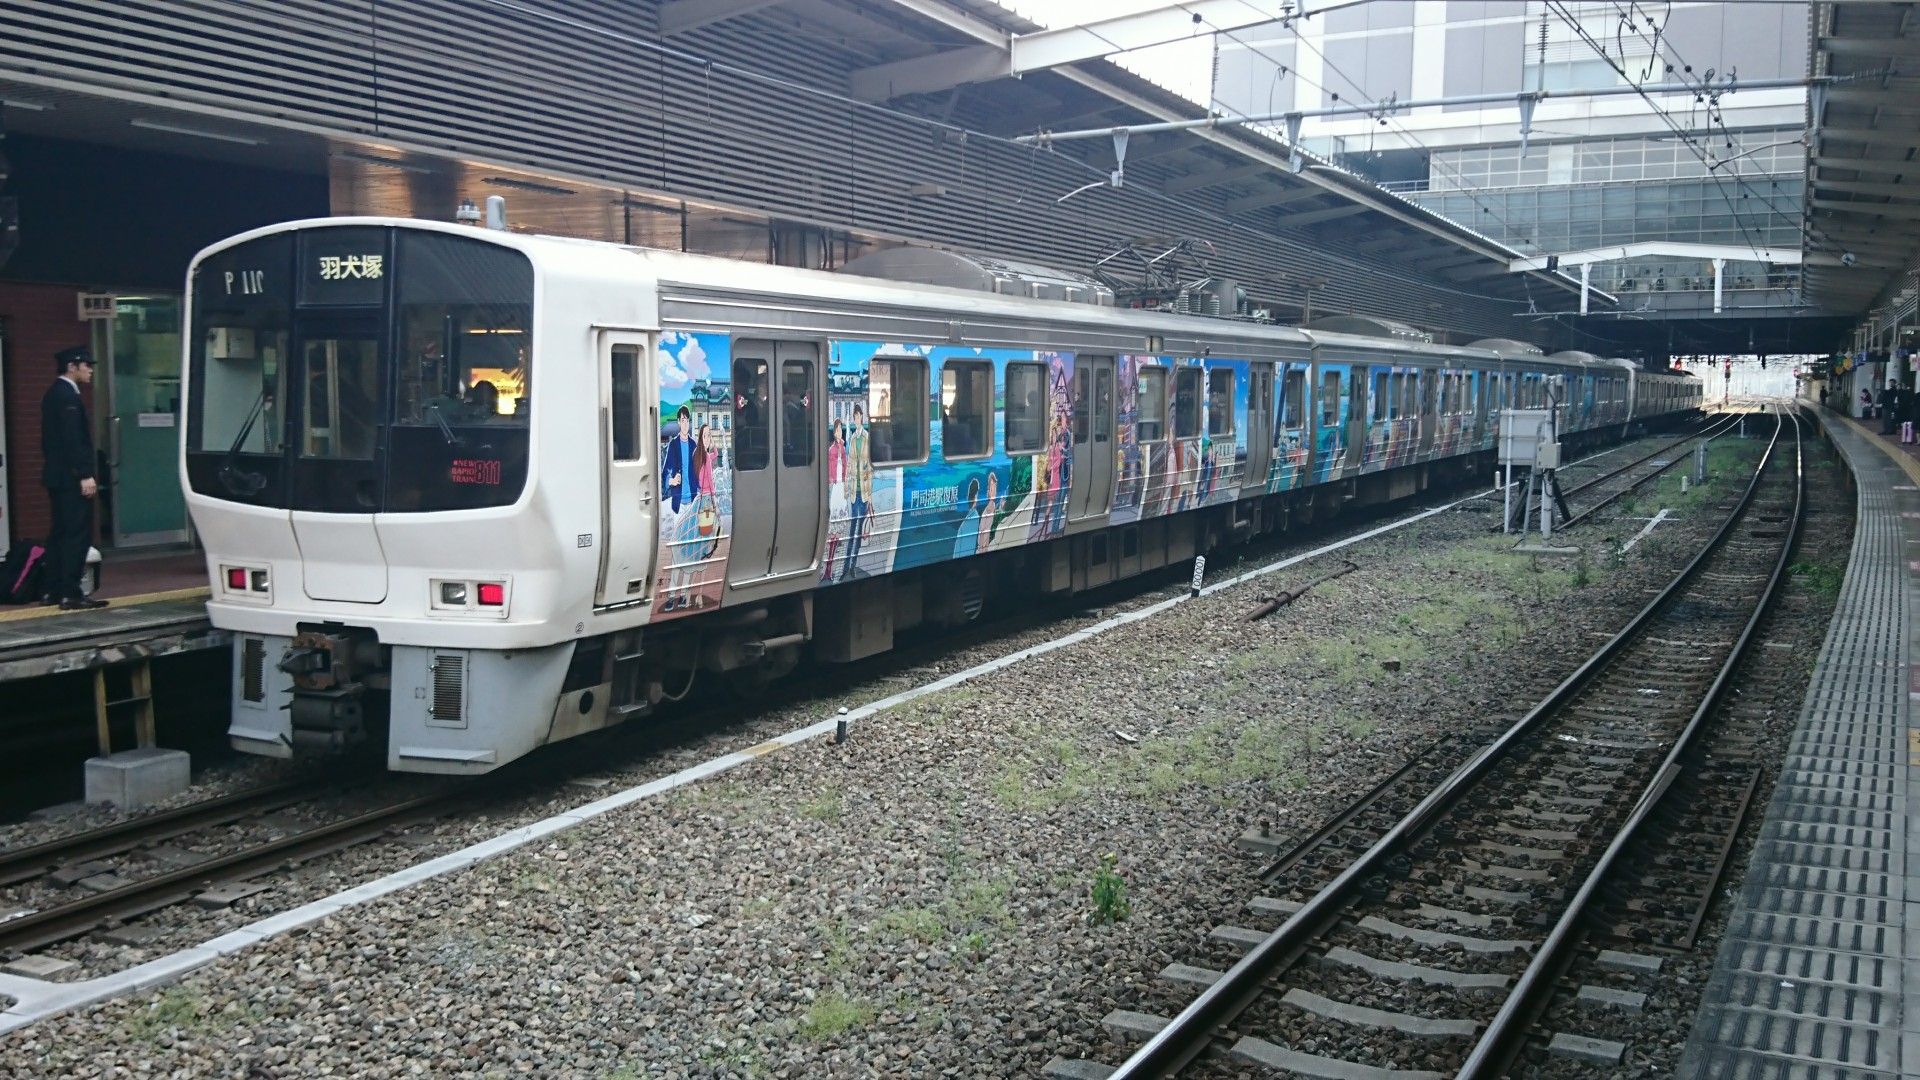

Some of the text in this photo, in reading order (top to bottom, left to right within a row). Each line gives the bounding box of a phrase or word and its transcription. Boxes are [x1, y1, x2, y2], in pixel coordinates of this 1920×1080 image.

[319, 254, 384, 280] 羽犬塚
[224, 271, 235, 295] P
[475, 460, 501, 485] 811
